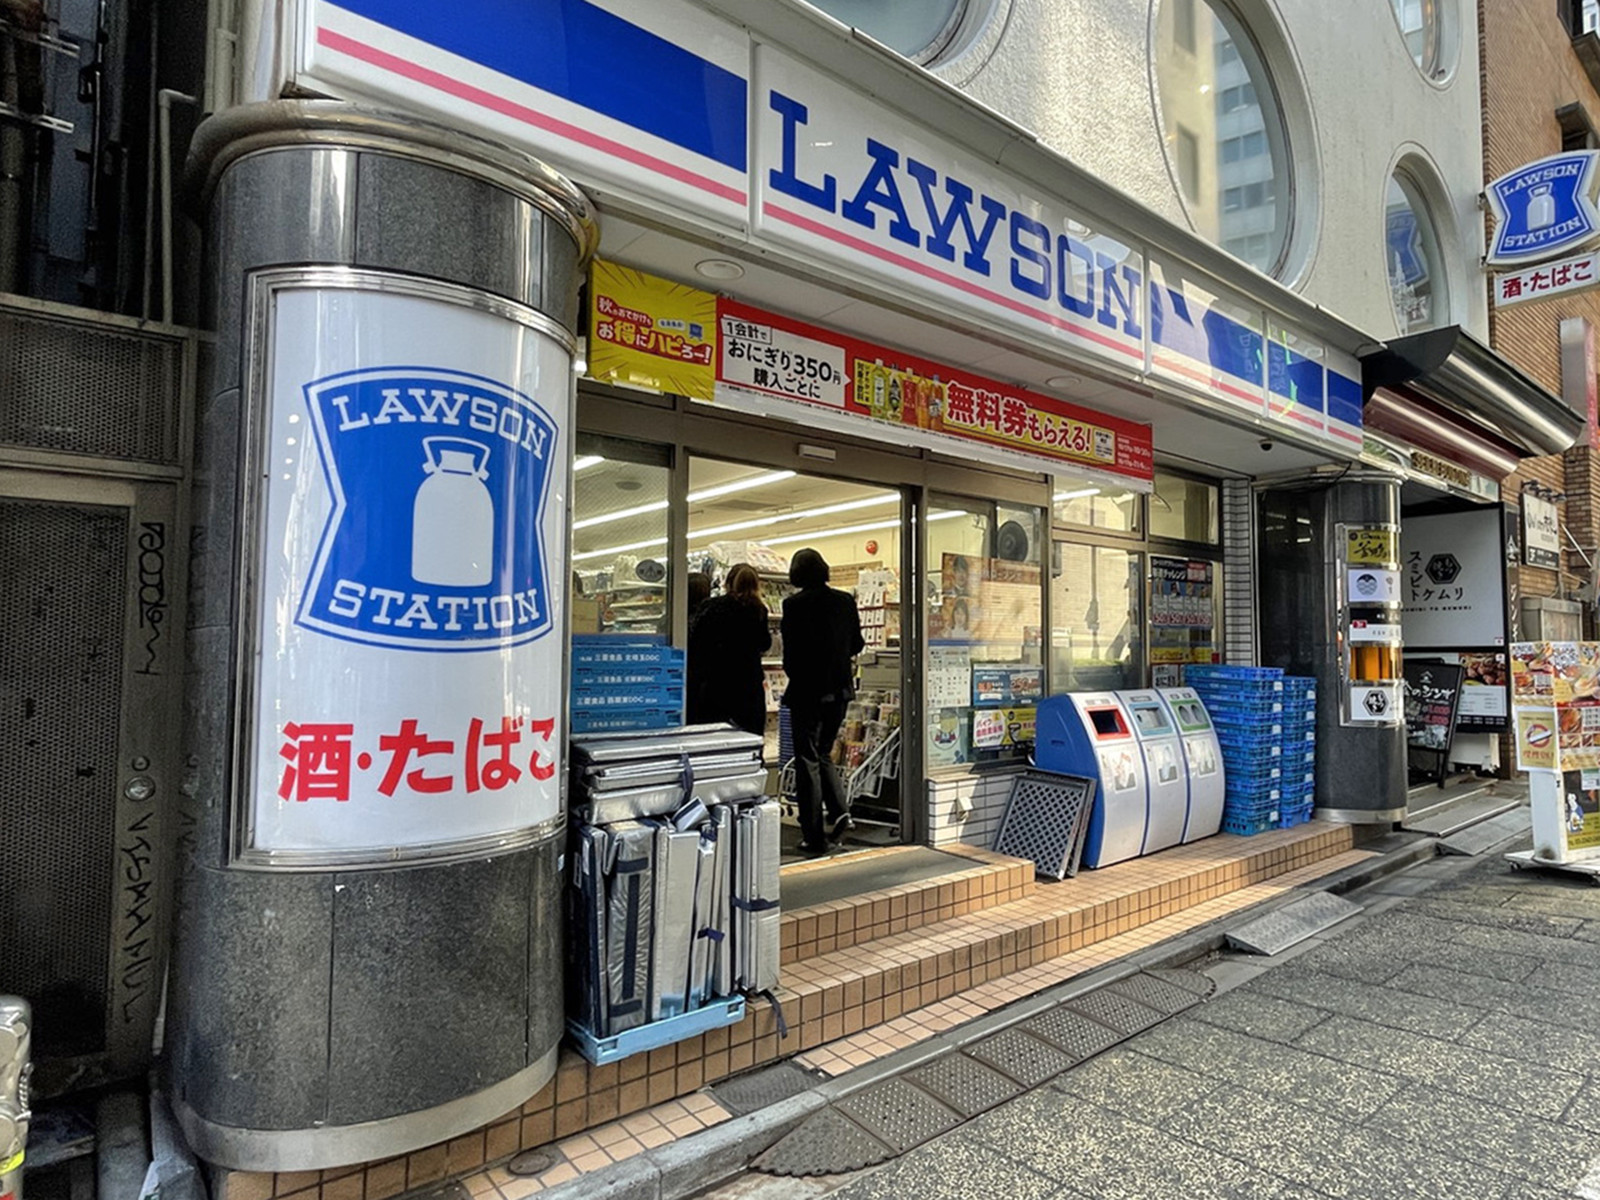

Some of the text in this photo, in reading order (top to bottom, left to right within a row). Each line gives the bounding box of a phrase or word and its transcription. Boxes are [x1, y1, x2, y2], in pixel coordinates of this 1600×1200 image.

[1502, 163, 1580, 197] LAWSON
[769, 89, 1142, 339] LAWSON
[1504, 216, 1582, 247] STATION
[727, 321, 768, 341] 1会計で
[728, 339, 841, 386] おにぎり350円
[754, 367, 821, 399] 購入ごとに
[332, 388, 547, 460] LAWSON
[947, 382, 1092, 452] 無料券もらえる!
[328, 579, 540, 631] STATION
